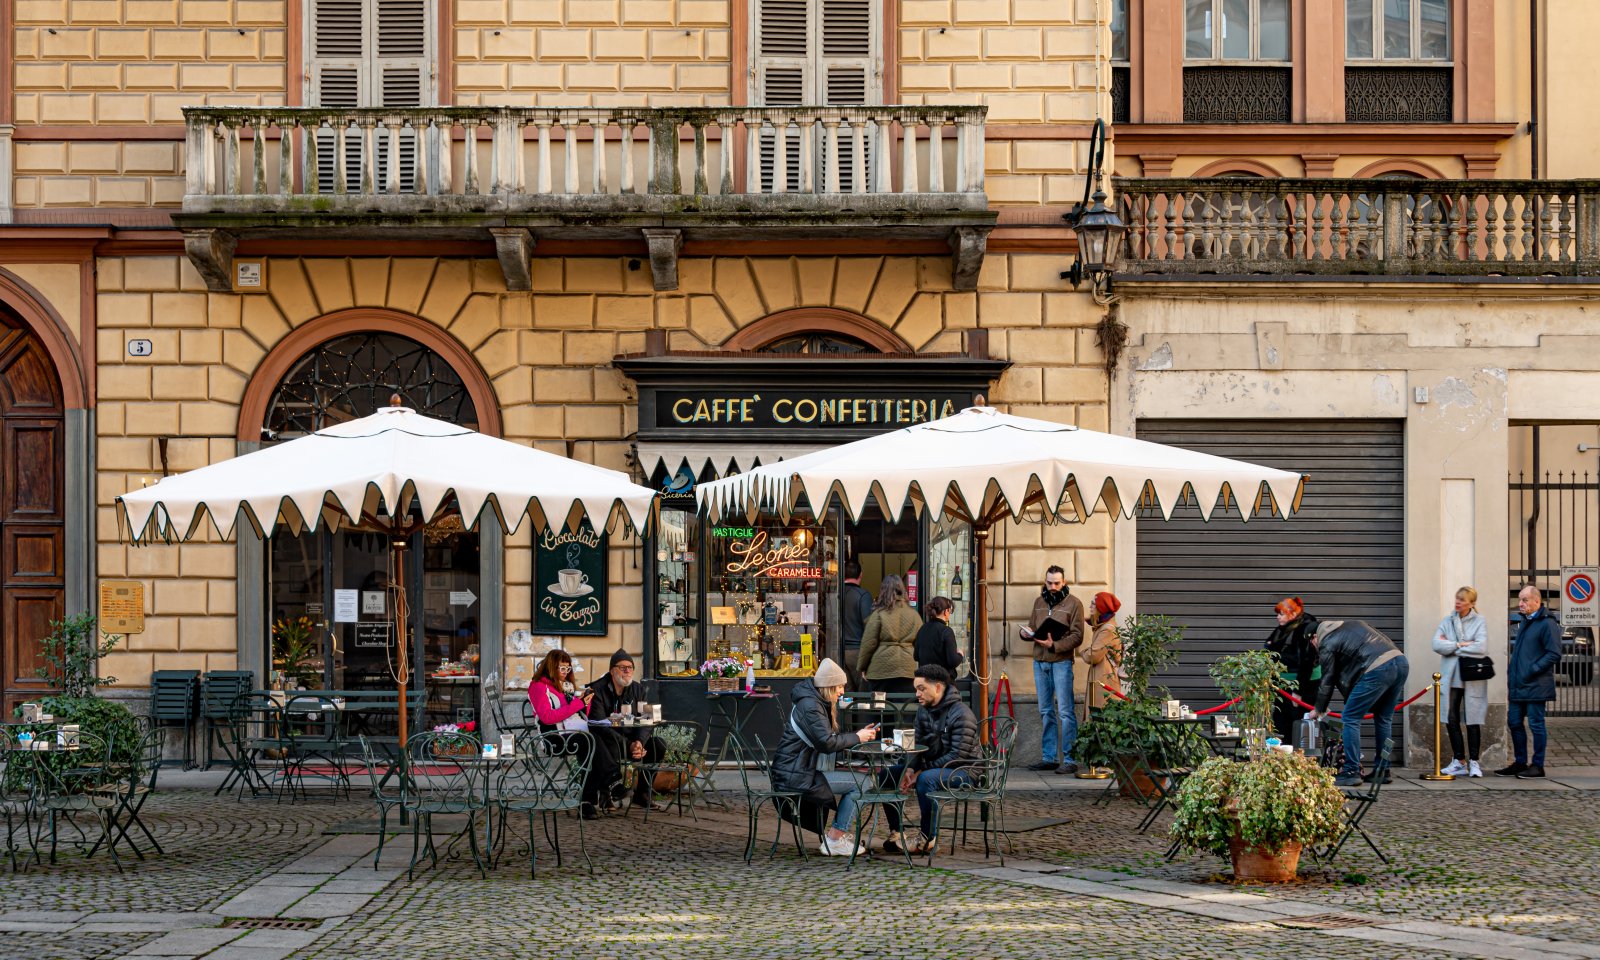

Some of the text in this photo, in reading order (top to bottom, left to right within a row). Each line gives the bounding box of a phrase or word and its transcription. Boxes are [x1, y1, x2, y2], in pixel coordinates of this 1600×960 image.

[137, 342, 144, 353] 5
[772, 399, 955, 423] CONFETTERIA
[713, 528, 753, 538] PASTIGLIE
[769, 568, 821, 578] CARAMELLE
